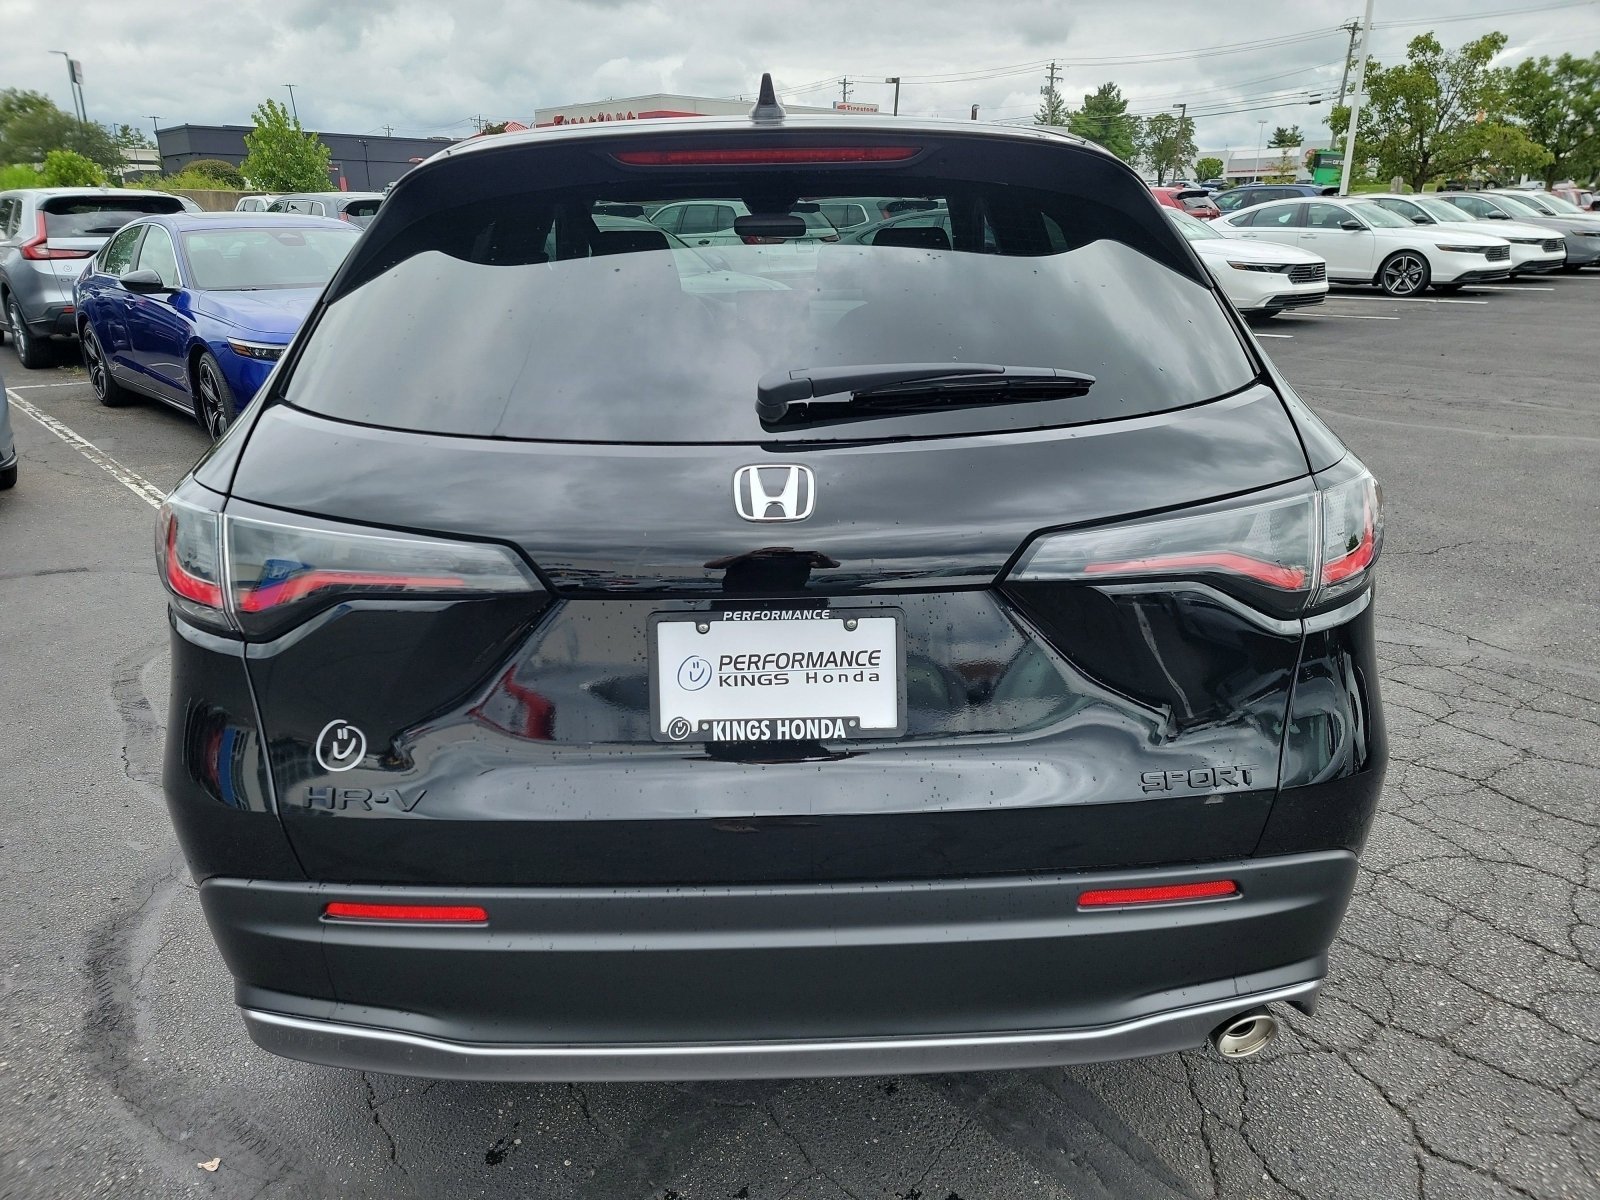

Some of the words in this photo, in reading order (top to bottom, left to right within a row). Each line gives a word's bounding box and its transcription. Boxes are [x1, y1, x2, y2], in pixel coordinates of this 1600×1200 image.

[723, 609, 831, 621] PERFORMANCE
[718, 649, 881, 672] PERFORMANCE
[718, 673, 789, 688] KINGS
[805, 670, 880, 684] Honda
[712, 720, 771, 741] KINGS
[776, 718, 847, 740] HONDA
[1140, 765, 1259, 793] SPORT
[303, 786, 428, 812] HR-V
